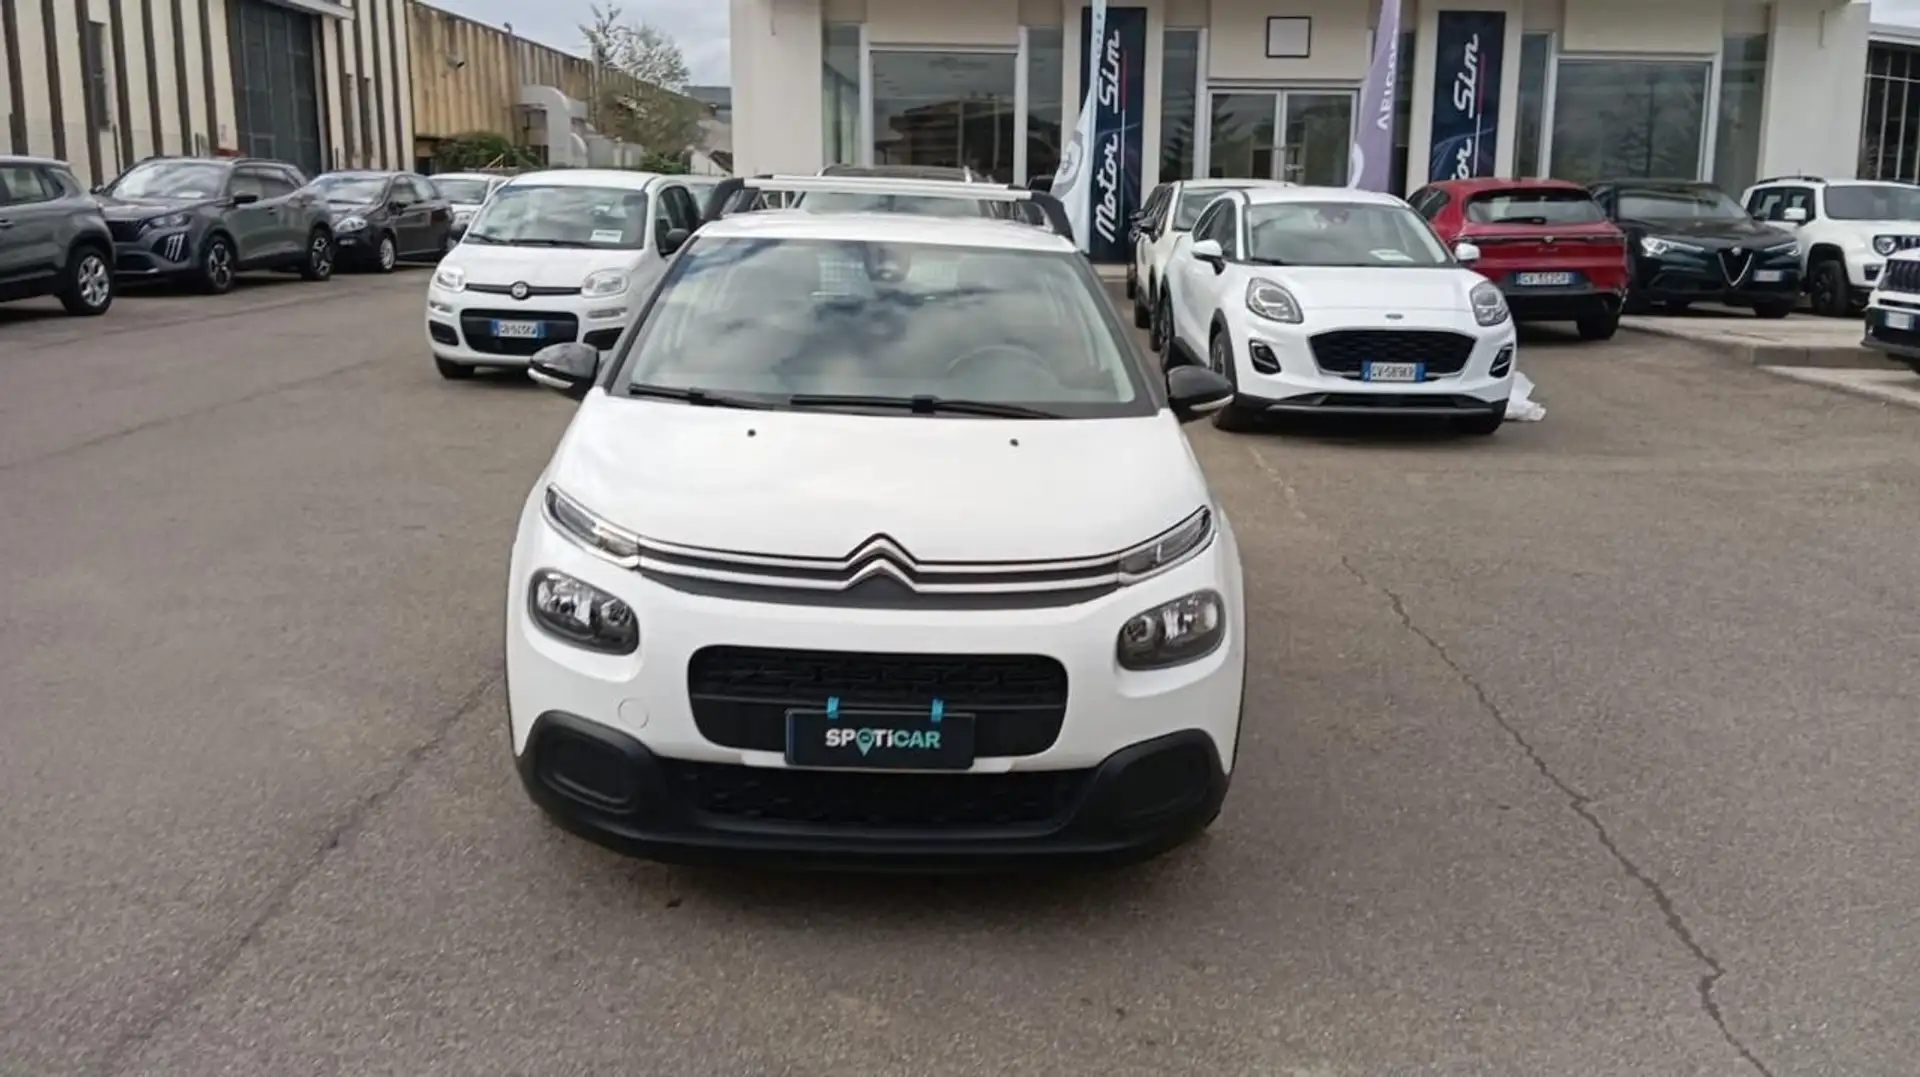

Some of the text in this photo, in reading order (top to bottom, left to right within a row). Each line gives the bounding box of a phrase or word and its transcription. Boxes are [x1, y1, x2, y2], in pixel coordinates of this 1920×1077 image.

[1095, 29, 1120, 243] Motor Sim
[1453, 33, 1479, 119] Sim
